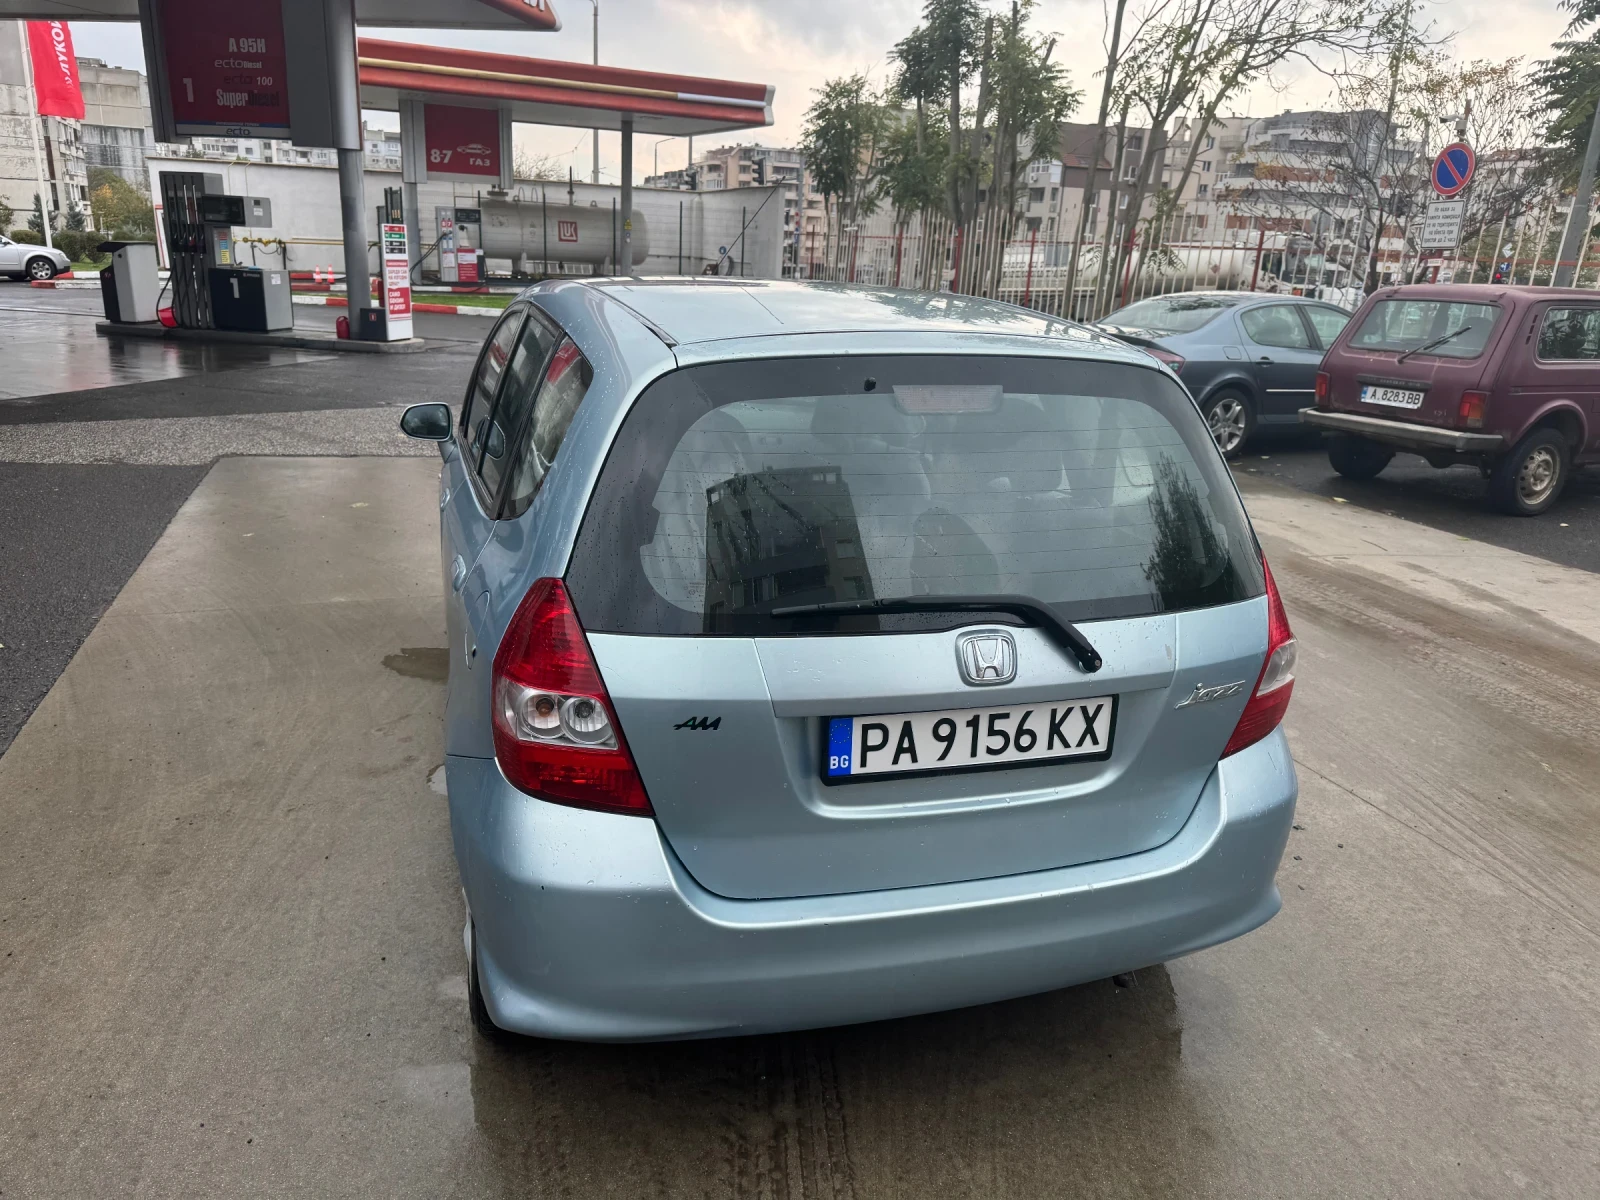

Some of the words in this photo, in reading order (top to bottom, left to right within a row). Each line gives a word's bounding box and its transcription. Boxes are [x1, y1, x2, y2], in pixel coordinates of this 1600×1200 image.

[228, 37, 238, 53] A
[239, 38, 267, 53] 95H
[256, 76, 273, 86] 100
[182, 77, 195, 103] 1
[226, 126, 251, 136] ecto
[469, 157, 491, 167] ГАЗ
[230, 277, 240, 299] 1
[859, 720, 919, 768] PA
[931, 709, 1038, 762] 9156
[1047, 703, 1104, 751] KX
[829, 755, 849, 770] BG
